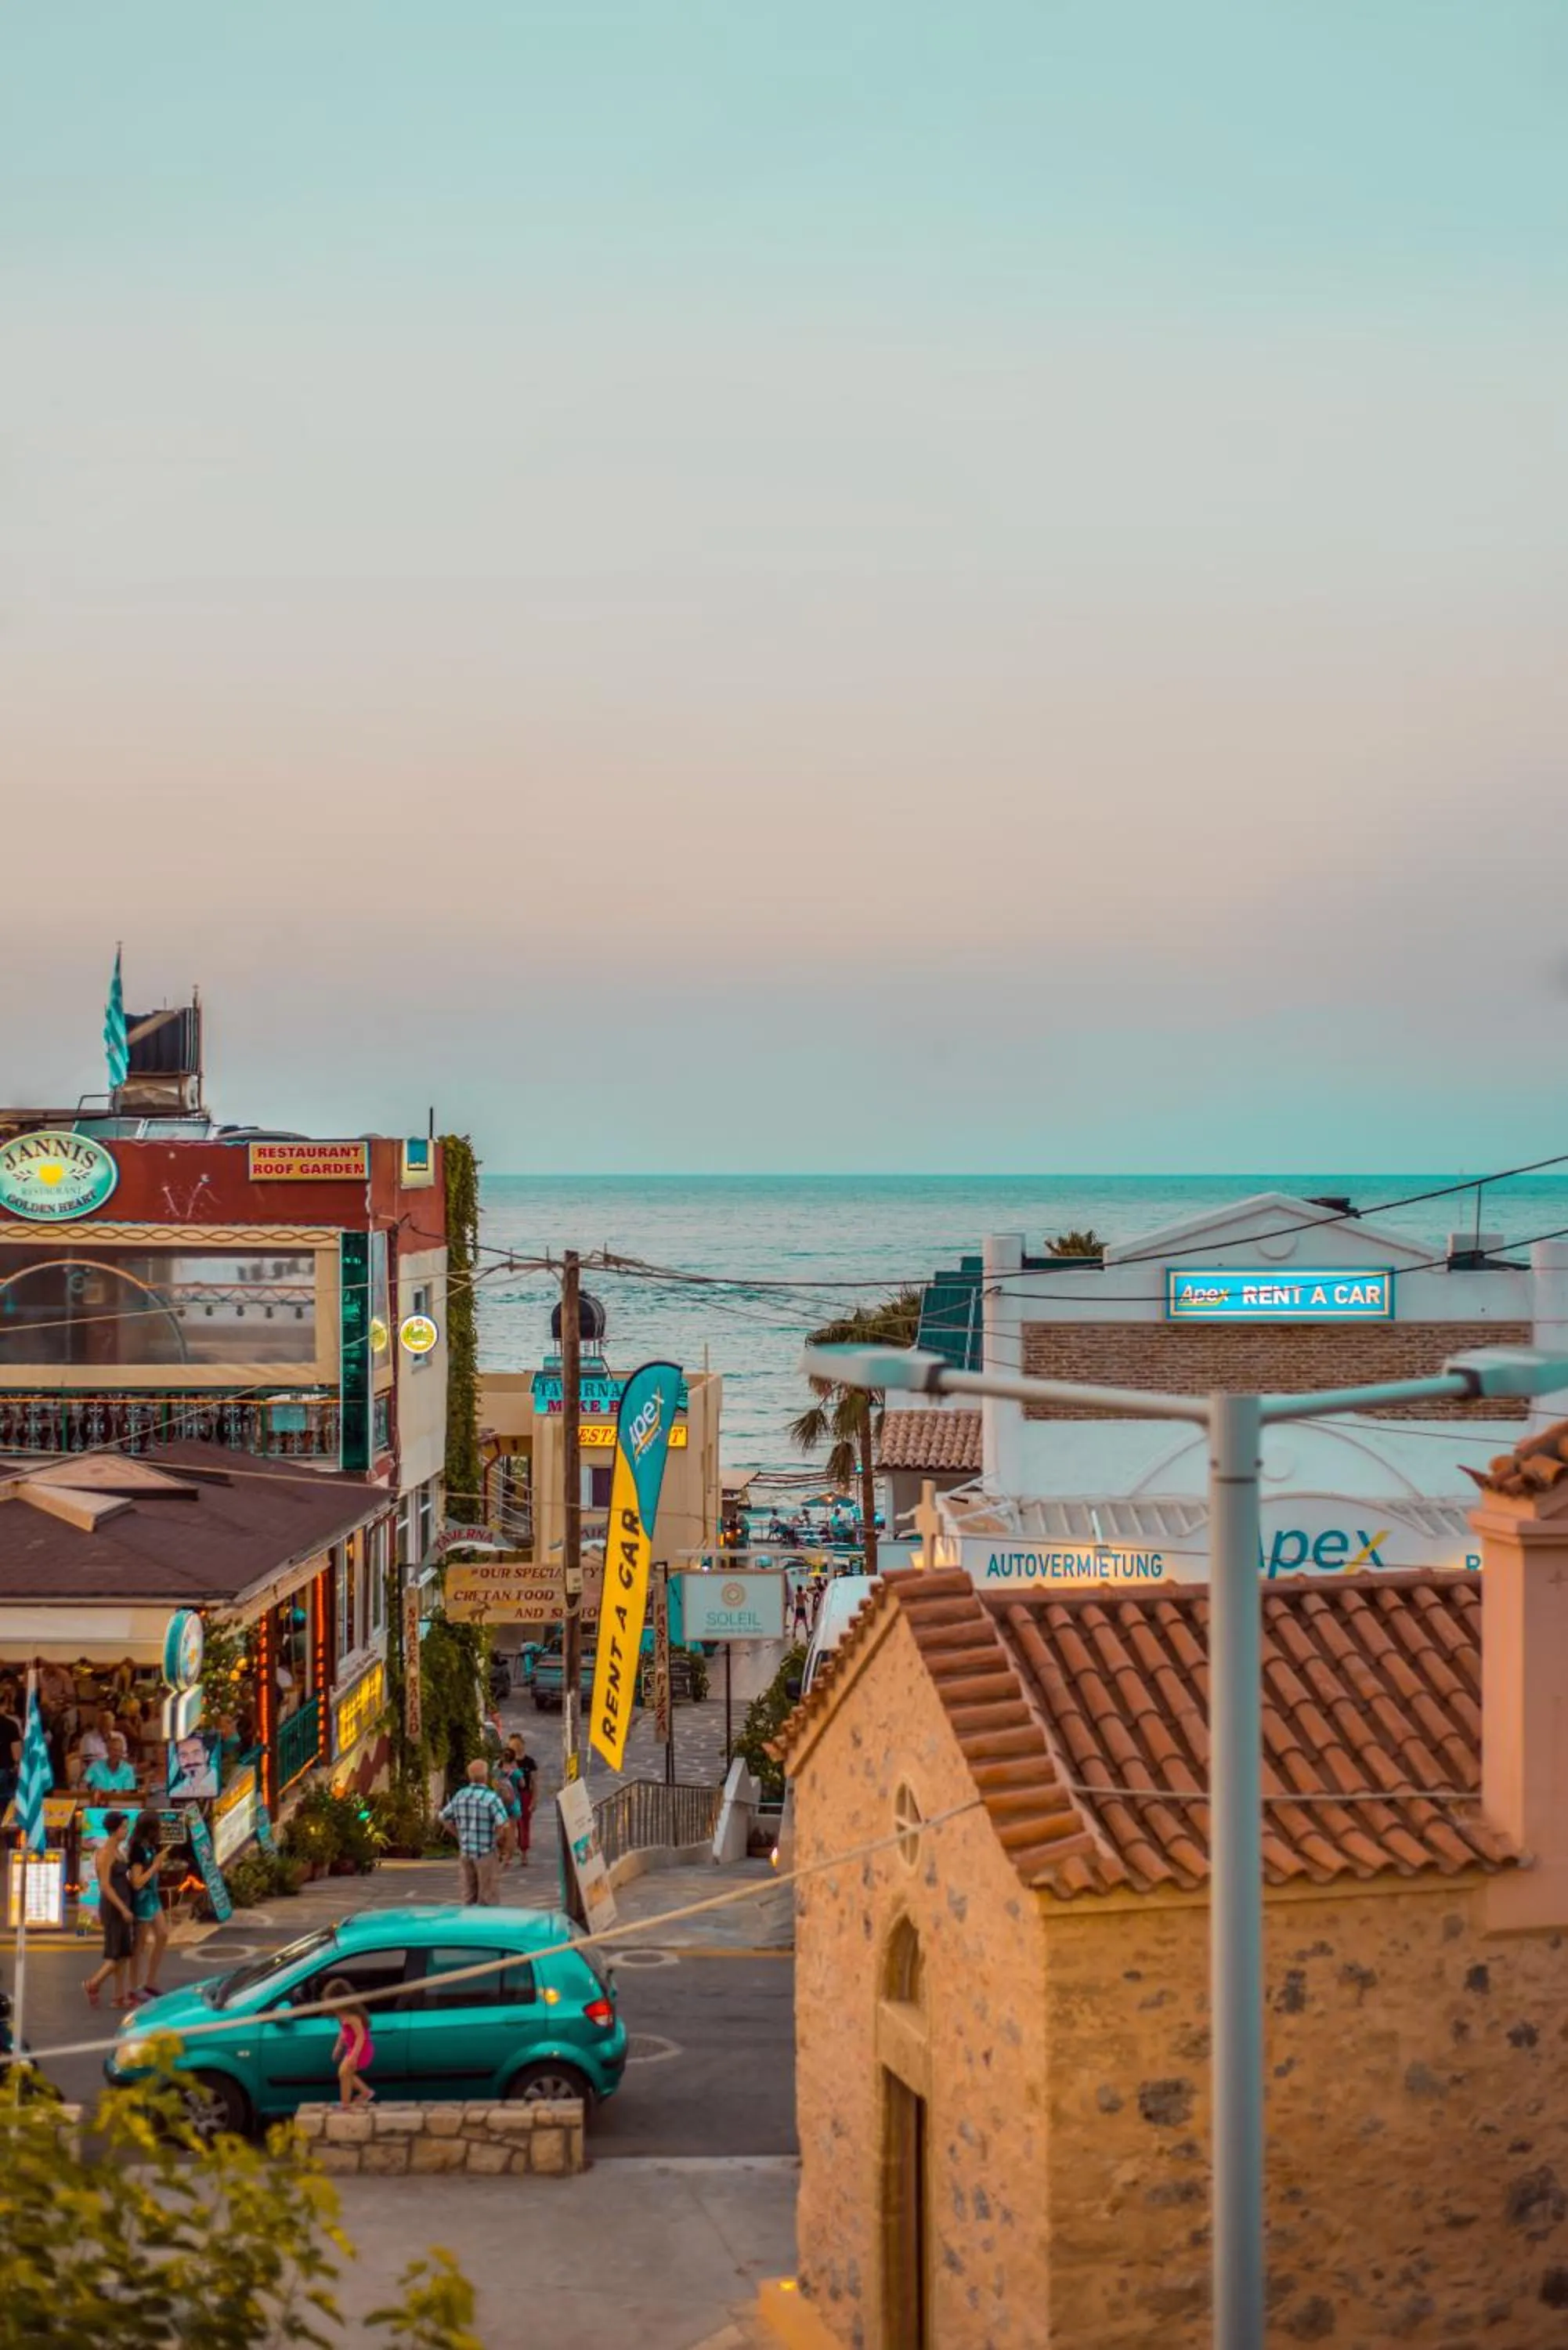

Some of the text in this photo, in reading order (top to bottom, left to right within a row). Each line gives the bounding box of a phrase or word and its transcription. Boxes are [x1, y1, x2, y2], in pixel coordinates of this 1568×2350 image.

[5, 1138, 97, 1170] JANNIS
[256, 1147, 361, 1158] RESTAURANT
[253, 1163, 365, 1174] ROOF GARDEN
[6, 1188, 97, 1213] GOLDEN HEART
[1180, 1285, 1382, 1304] Apex RENT A CAR
[547, 1400, 602, 1412] MKE
[437, 1528, 494, 1552] TAVERNA
[987, 1553, 1164, 1578] AUTOVERMIETUNG
[453, 1590, 511, 1601] CRETAN
[514, 1607, 544, 1619] AND
[706, 1611, 762, 1626] SOLEIL
[602, 1507, 641, 1746] RENT A CAR
[407, 1607, 419, 1734] SNACK SALAD
[656, 1603, 667, 1733] PASTA PIZZA
